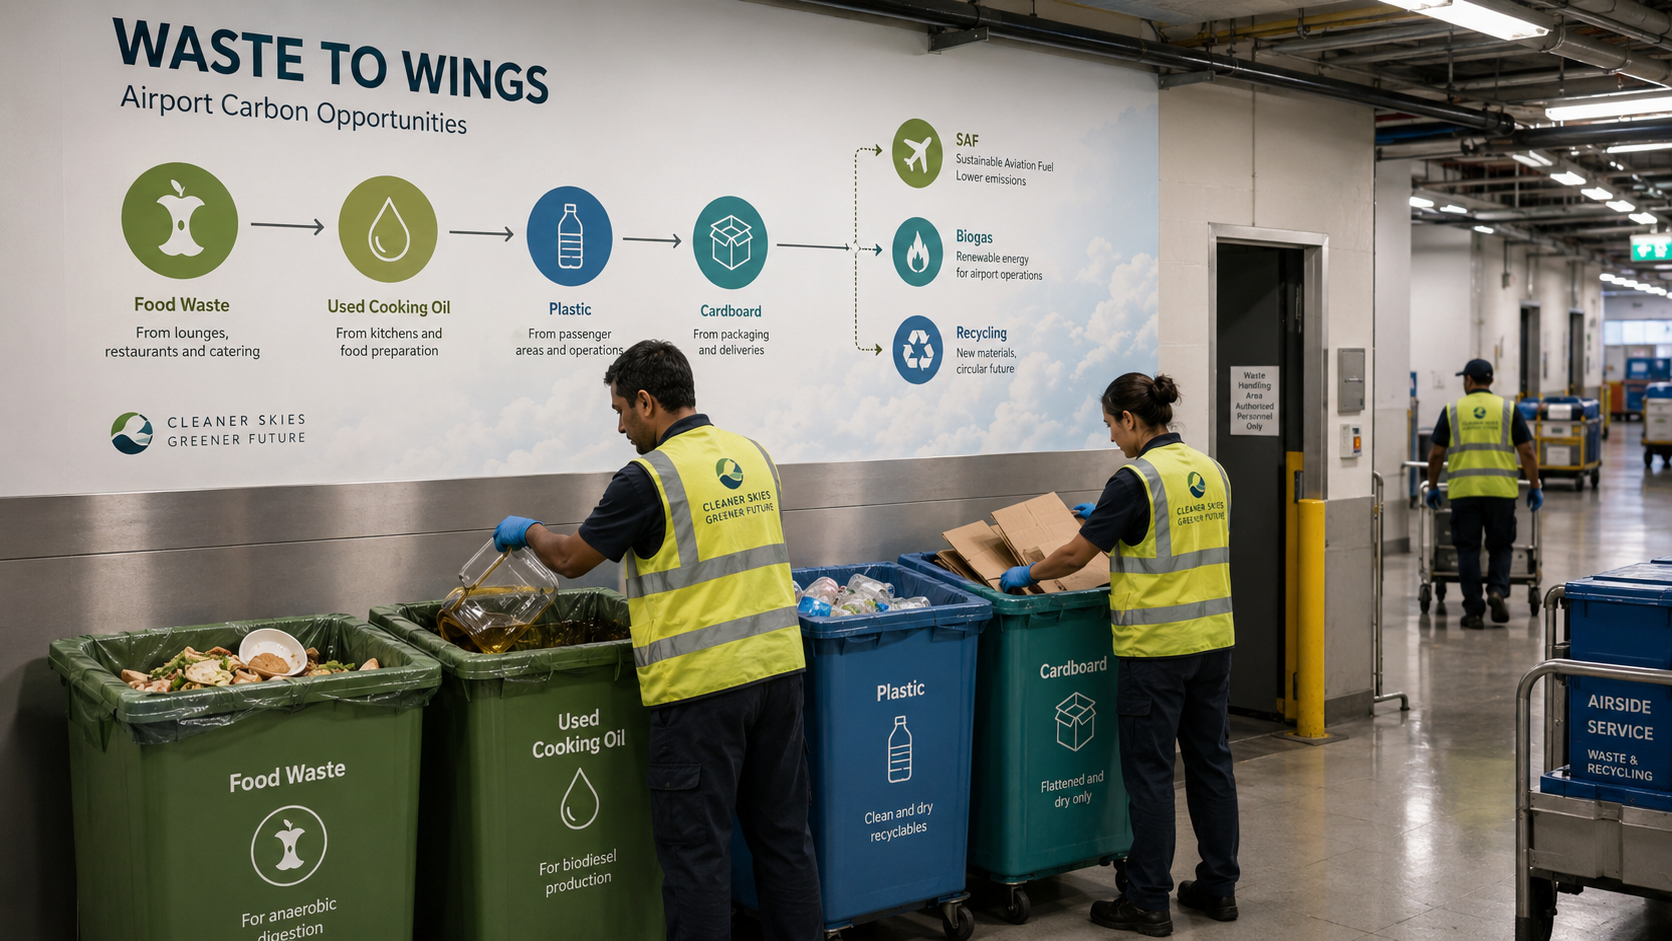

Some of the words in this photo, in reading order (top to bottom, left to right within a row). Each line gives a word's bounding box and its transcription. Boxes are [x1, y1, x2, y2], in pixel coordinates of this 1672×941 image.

[112, 17, 303, 81] WASTE
[321, 41, 387, 88] TO
[402, 51, 548, 104] WINGS
[121, 85, 213, 116] Airport
[222, 94, 308, 121] Carbon
[318, 102, 466, 134] Opportunities
[957, 133, 979, 147] SAF
[956, 153, 1002, 167] Sustainable
[1005, 158, 1036, 169] Aviation
[1038, 161, 1053, 172] Fuel
[957, 170, 983, 182] Lower
[985, 175, 1026, 186] emissions
[957, 229, 993, 246] Biogas
[957, 251, 1000, 263] Renewable
[1002, 256, 1029, 266] energy
[957, 267, 968, 278] for
[970, 268, 998, 280] airport
[1001, 271, 1042, 281] operations
[135, 297, 175, 311] Food
[180, 297, 229, 312] Waste
[328, 299, 364, 313] Used
[369, 300, 427, 317] Cooking
[432, 301, 450, 313] Oil
[550, 302, 591, 315] Plastic
[701, 305, 761, 317] Cardboard
[137, 327, 170, 338] From
[175, 327, 228, 341] lounges,
[337, 327, 366, 338] From
[370, 327, 419, 339] kitchens
[421, 327, 442, 339] and
[529, 328, 556, 339] From
[560, 331, 611, 342] passenger
[694, 329, 718, 339] From
[721, 329, 769, 342] packaging
[957, 326, 1007, 342] Recycling
[105, 346, 179, 357] restaurants
[182, 345, 206, 357] and
[210, 345, 260, 359] catering
[340, 345, 368, 357] food
[371, 345, 439, 360] preparation
[515, 346, 545, 356] areas
[547, 345, 566, 355] and
[569, 345, 624, 358] operations
[699, 345, 717, 356] and
[719, 345, 765, 356] deliveries
[957, 348, 975, 358] New
[977, 348, 1017, 359] materials,
[957, 364, 987, 374] circular
[990, 363, 1014, 373] future
[1243, 371, 1266, 380] Waste
[168, 416, 247, 428] CLEANER
[259, 414, 305, 425] SKIES
[1246, 422, 1263, 431] Only
[168, 435, 239, 447] GREENER
[249, 432, 304, 444] FUTURE
[703, 495, 745, 512] CLEANER
[747, 490, 771, 503] SKIES
[705, 508, 745, 524] GREENER
[746, 502, 774, 515] FUTURE
[1040, 656, 1106, 679] Cardboard
[878, 680, 924, 701] Plastic
[1587, 694, 1652, 715] AIRSIDE
[559, 709, 598, 730] Used
[1588, 720, 1653, 740] SERVICE
[533, 736, 599, 758] Cooking
[604, 729, 625, 747] Oil
[1587, 749, 1627, 764] WASTE
[1630, 755, 1638, 765] &
[230, 768, 279, 792] Food
[286, 762, 345, 784] Waste
[1587, 763, 1653, 782] RECYCLING
[1041, 775, 1085, 794] Flattened
[1087, 769, 1104, 785] and
[1055, 796, 1070, 808] dry
[1073, 791, 1092, 804] only
[865, 811, 893, 824] Clean
[896, 804, 914, 818] and
[917, 802, 933, 815] dry
[870, 820, 928, 843] recyclables
[540, 862, 560, 875] For
[563, 849, 616, 871] biodiesel
[546, 871, 612, 898] production
[243, 913, 265, 927] For
[269, 898, 336, 922] anaerobic
